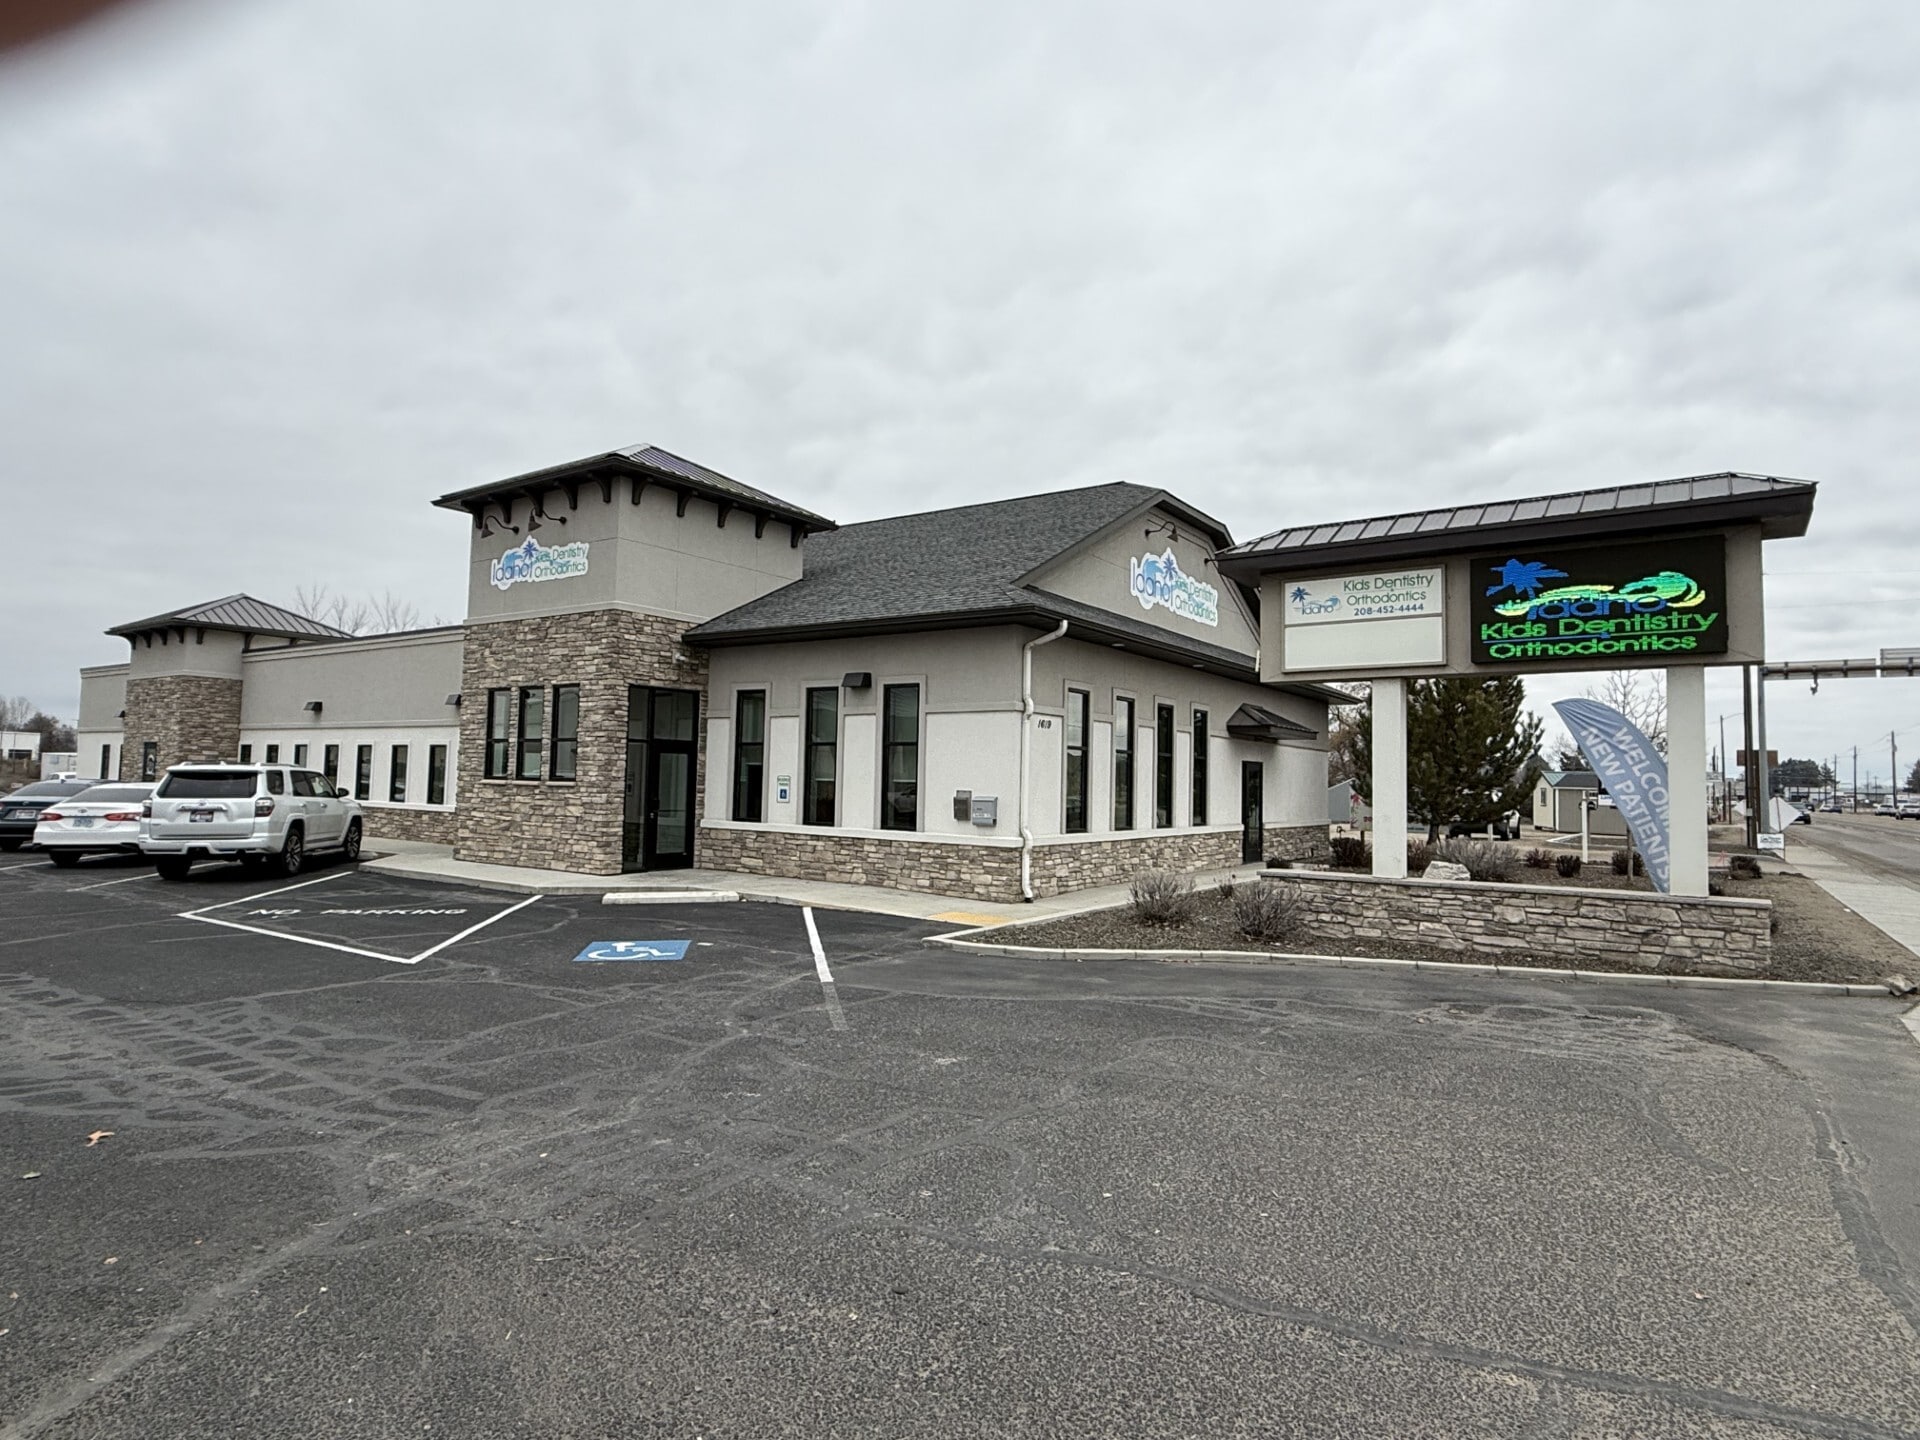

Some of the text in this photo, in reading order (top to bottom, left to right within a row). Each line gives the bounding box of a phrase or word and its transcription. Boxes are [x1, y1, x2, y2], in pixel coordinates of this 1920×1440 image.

[552, 546, 587, 561] Dentistry
[492, 561, 529, 583] Idaho
[534, 561, 587, 578] Orthodontics
[1132, 561, 1171, 603] Idaho
[1343, 573, 1434, 592] Kids Dentistry
[1346, 589, 1427, 606] Orthodontics
[1353, 603, 1424, 616] 208-452-4444
[1481, 611, 1718, 640] Kids Dentistry
[1488, 634, 1698, 658] Orthodontics
[1580, 727, 1626, 777] NEW
